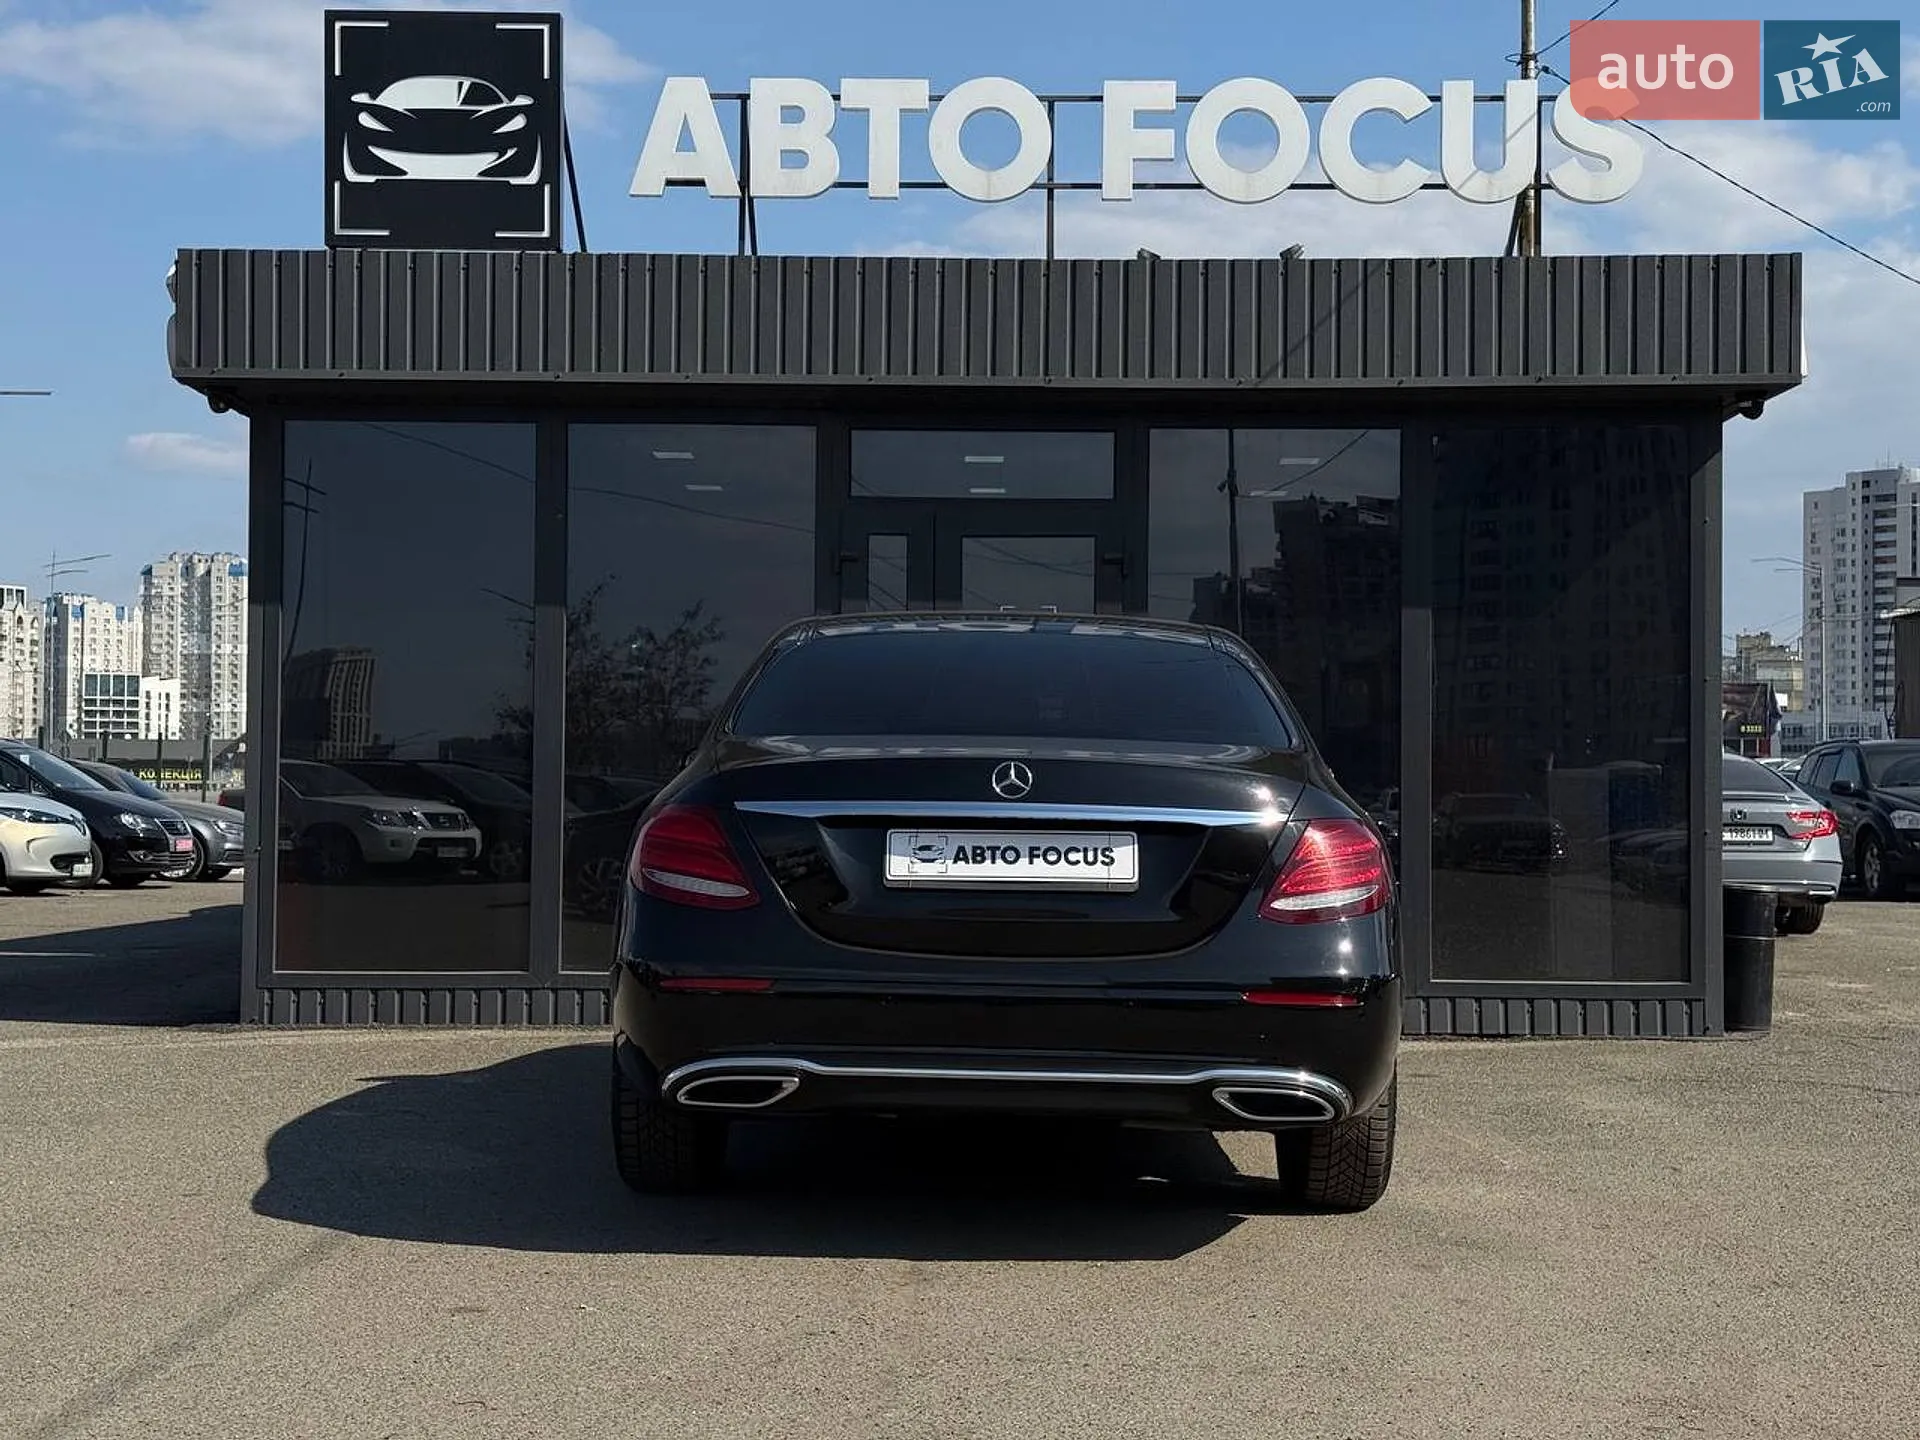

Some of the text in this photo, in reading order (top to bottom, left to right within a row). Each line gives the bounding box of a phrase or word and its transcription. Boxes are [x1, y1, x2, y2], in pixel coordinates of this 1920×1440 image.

[1100, 76, 1644, 204] FOCUS
[139, 767, 203, 781] КОЕКЦІЯ
[1028, 846, 1116, 867] FOCUS
